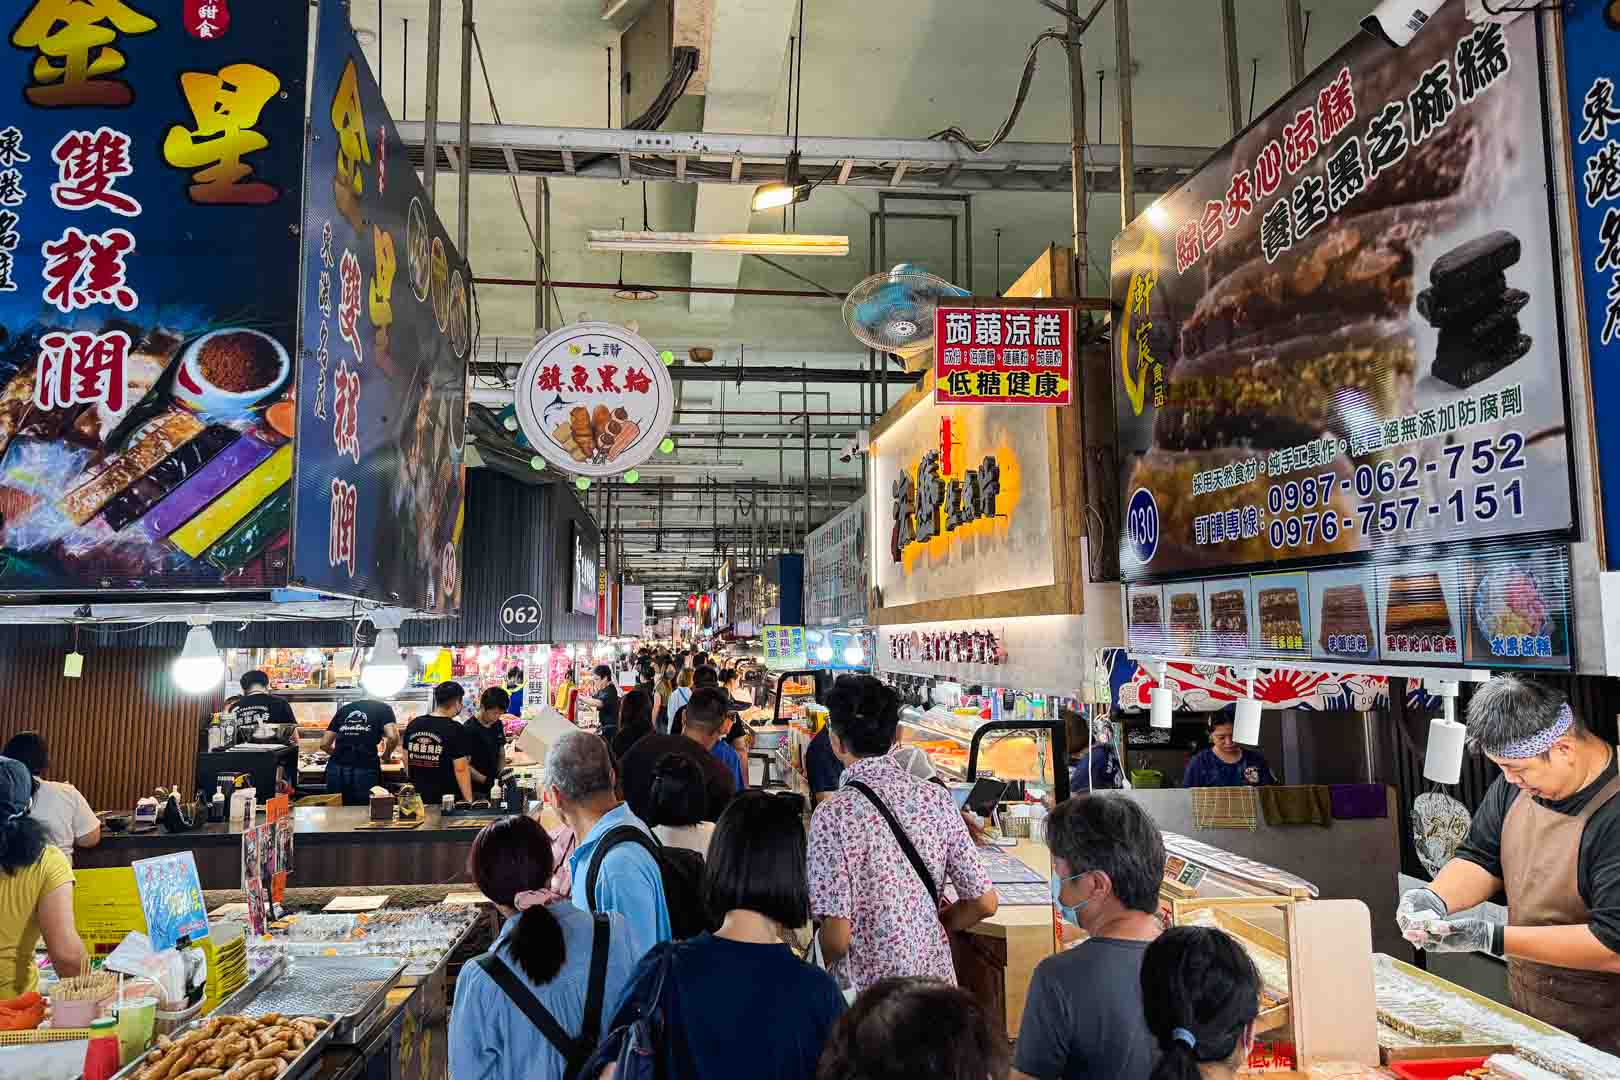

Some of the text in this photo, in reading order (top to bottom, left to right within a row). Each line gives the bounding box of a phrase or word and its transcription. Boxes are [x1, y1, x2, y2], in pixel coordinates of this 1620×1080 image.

[1175, 67, 1356, 273] 綜合夾心涼糕
[1261, 22, 1511, 263] 養生黑芝麻糕
[34, 126, 142, 413] 雙糕潤
[945, 312, 1061, 346] 蒟蒻涼糕
[946, 370, 1060, 397] 低糖健康
[1152, 362, 1164, 408] 食品
[1268, 431, 1525, 515] 0987-062-752
[1130, 505, 1155, 545] 030
[1269, 479, 1524, 550] 0976-757-151
[503, 606, 538, 624] 062
